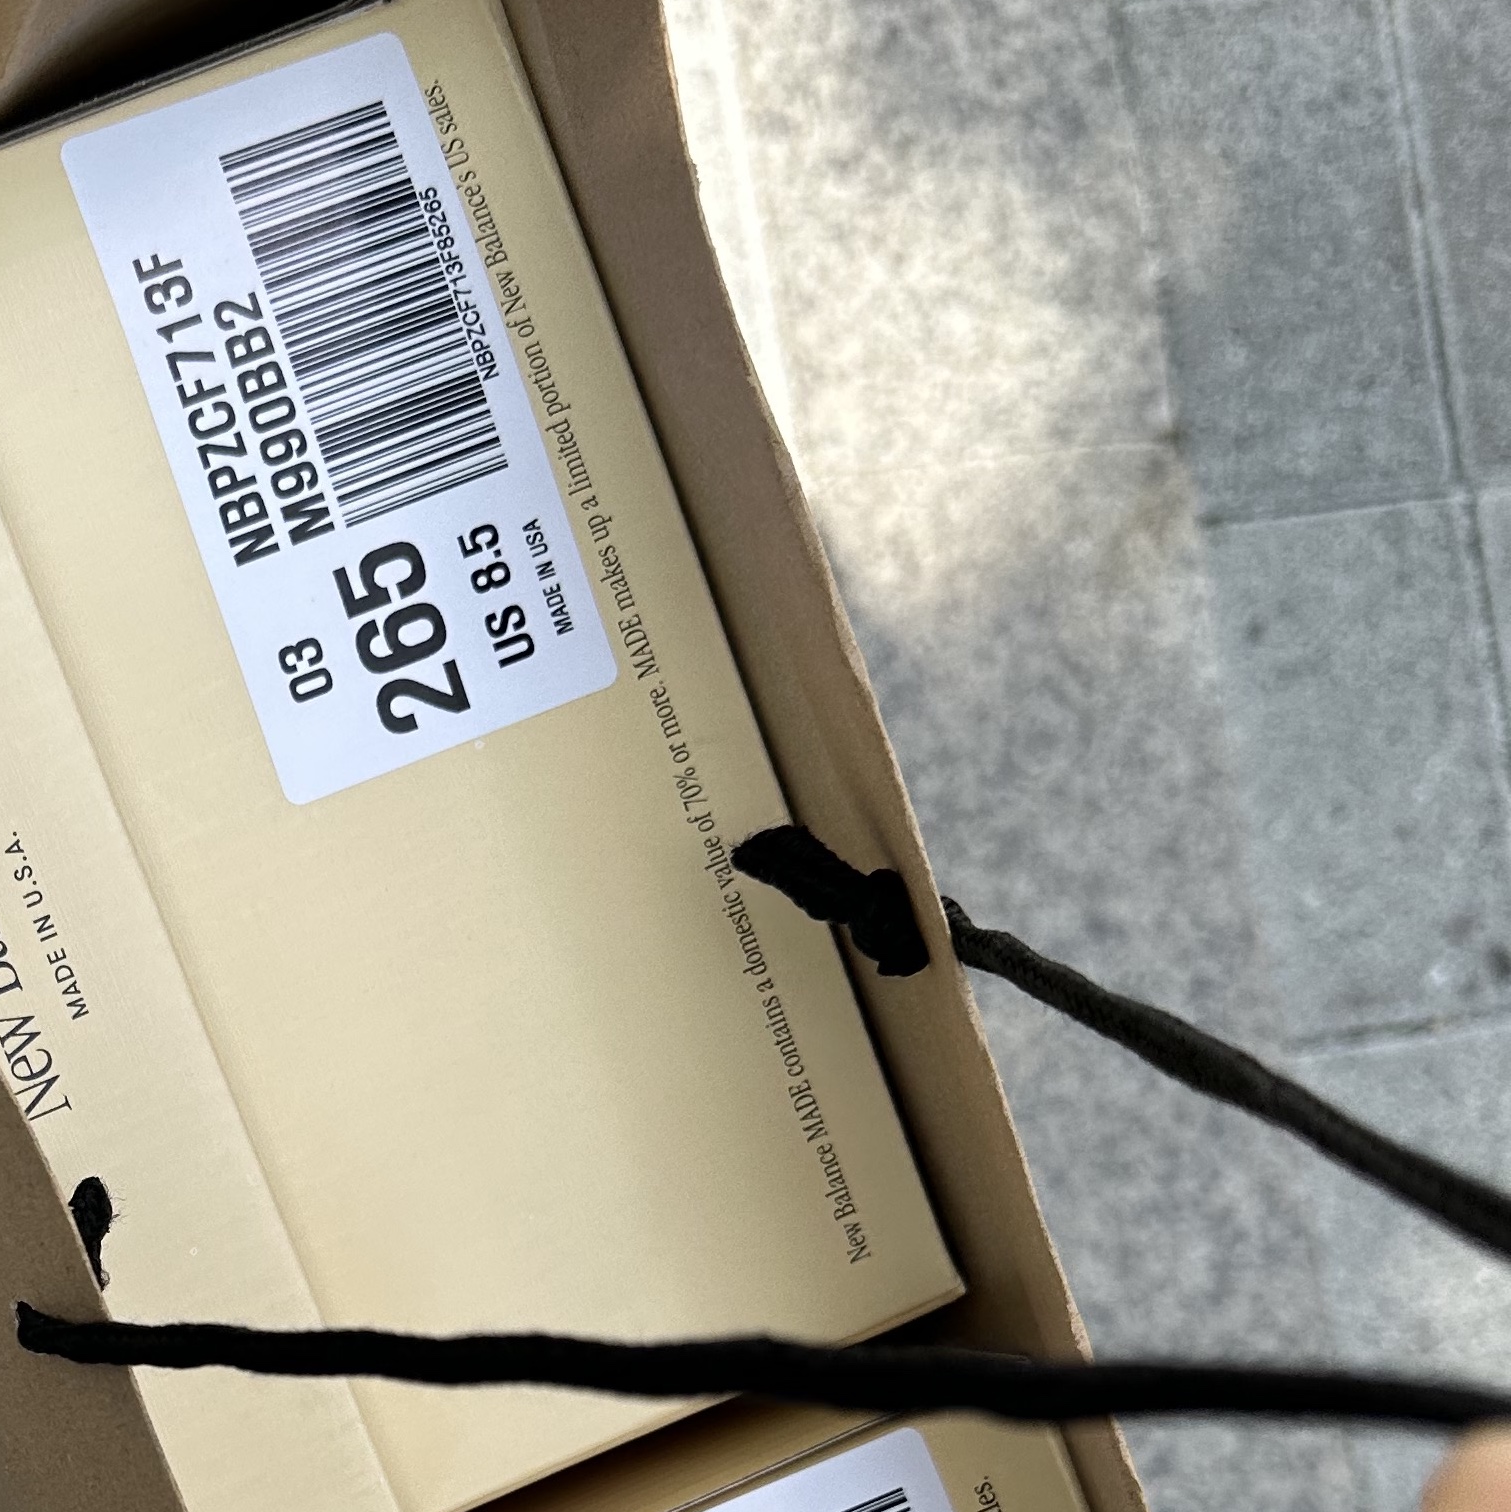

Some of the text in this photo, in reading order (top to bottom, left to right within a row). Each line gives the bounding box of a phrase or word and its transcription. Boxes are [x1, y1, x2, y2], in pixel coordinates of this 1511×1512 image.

[424, 78, 458, 136] sales.
[440, 137, 470, 170] US
[418, 186, 500, 382] NBPZCF713F85265
[495, 270, 527, 317] New
[505, 315, 535, 338] of
[131, 253, 281, 568] NBPZCF713F
[524, 340, 572, 417] portion
[213, 291, 336, 546] M990BB2
[544, 417, 593, 497] limited
[580, 494, 599, 511] a
[587, 514, 613, 544] up
[456, 523, 535, 669] US 8.5
[522, 518, 575, 636] MADE IN USA
[597, 544, 636, 612] makes
[278, 637, 334, 704] 03
[332, 541, 471, 734] 265
[617, 613, 660, 681] MADE
[649, 680, 682, 739] more.
[668, 741, 690, 764] or
[672, 766, 708, 813] 70%
[686, 811, 715, 833] of
[703, 836, 735, 891] value
[4, 831, 90, 1021] MADE IN U.S.A.
[721, 890, 768, 976] domestic
[756, 977, 775, 993] a
[762, 995, 805, 1077] contains
[788, 1078, 829, 1144] MADE
[816, 1142, 857, 1221] Balance
[843, 1221, 872, 1265] New
